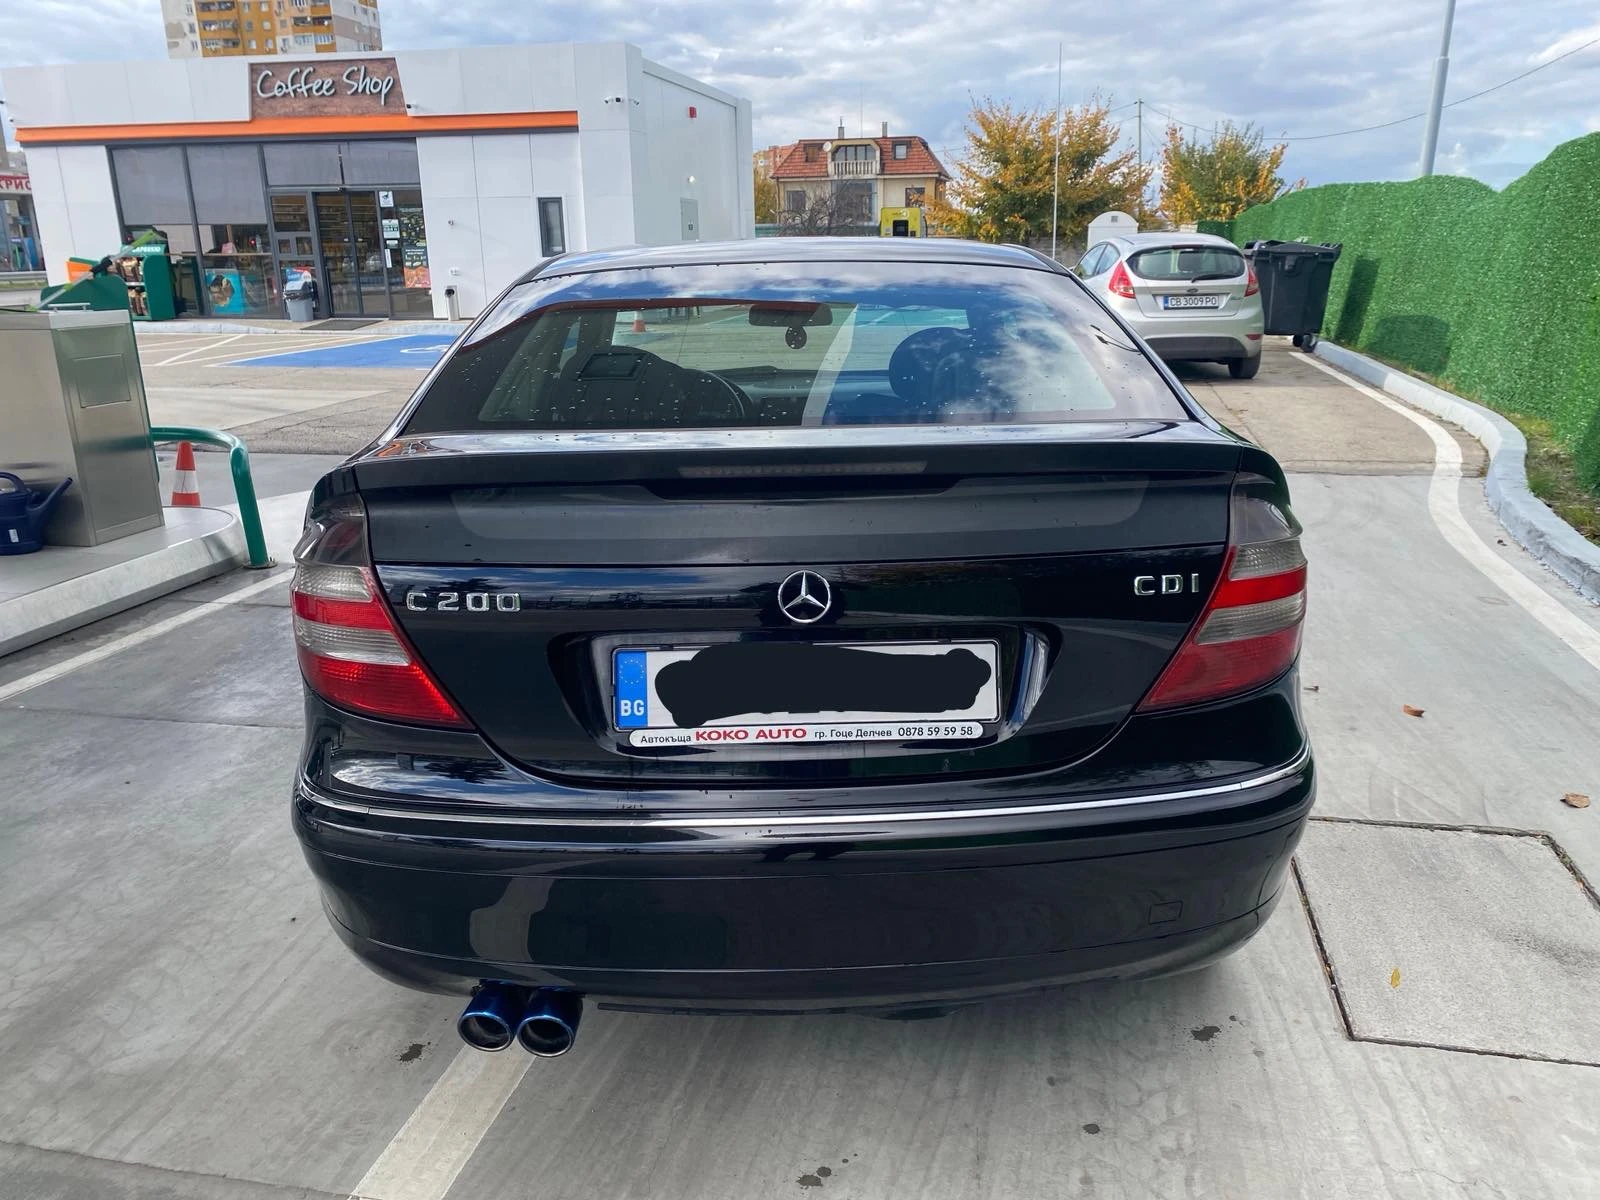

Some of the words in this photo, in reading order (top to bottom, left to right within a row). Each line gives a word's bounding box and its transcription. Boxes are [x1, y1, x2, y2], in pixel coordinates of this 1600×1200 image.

[257, 67, 336, 98] Coffee
[343, 65, 394, 106] Shop
[1134, 573, 1199, 595] CDI
[406, 592, 427, 611] C
[438, 592, 520, 612] 200
[620, 700, 645, 716] BG
[640, 735, 691, 744] Автокъща
[695, 729, 749, 741] KOKO
[755, 728, 806, 740] AUTO
[814, 731, 827, 739] гр.
[830, 729, 853, 739] Гоце
[855, 728, 892, 738] Делчев
[898, 727, 924, 737] 0878
[927, 726, 940, 736] 59
[943, 726, 957, 736] 59
[960, 725, 973, 736] 58
